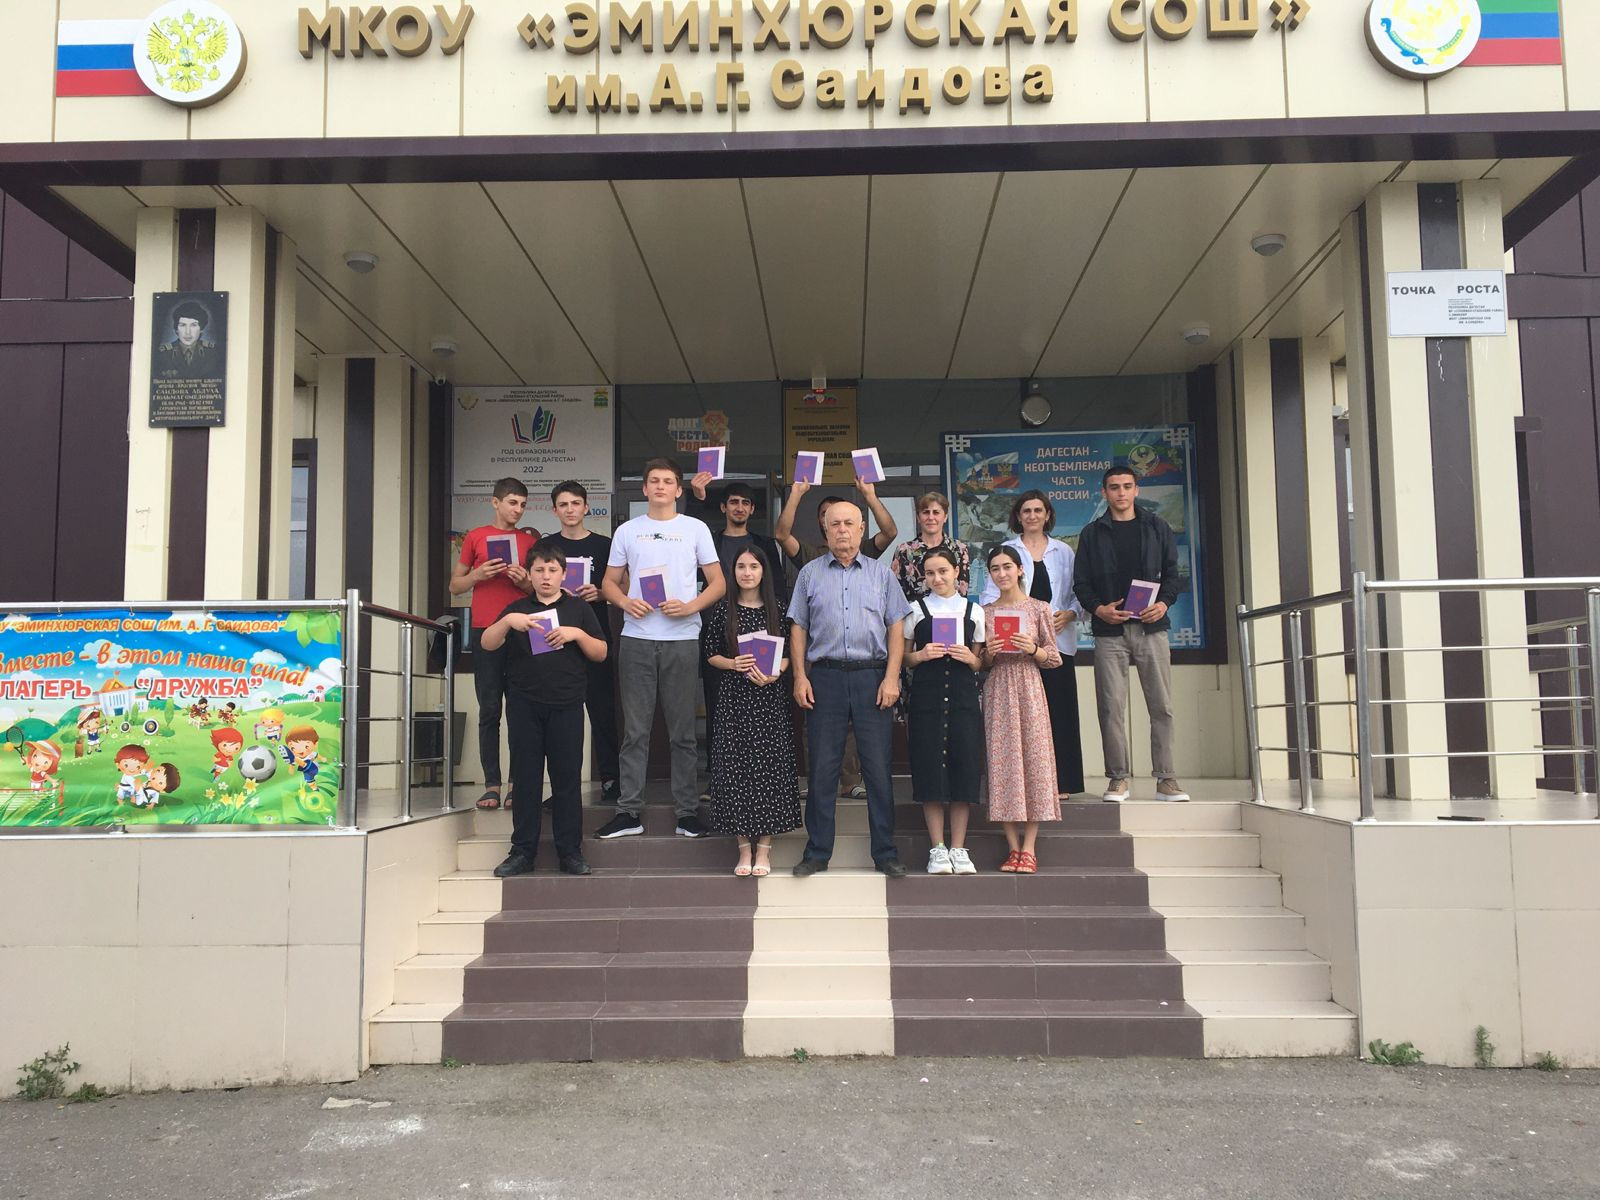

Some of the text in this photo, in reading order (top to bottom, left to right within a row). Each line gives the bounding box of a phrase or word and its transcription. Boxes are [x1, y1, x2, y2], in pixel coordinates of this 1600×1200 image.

[298, 0, 1311, 58] МКОУ «ЭМИНХЮРСКАЯ СОШ»
[770, 59, 1054, 115] Саидова
[1391, 285, 1500, 295] ТОЧКА РОСТА
[1036, 446, 1090, 458] ДАГЕСТАН
[522, 465, 544, 473] 2022
[1024, 460, 1111, 472] НЕОТЪЕМЛЕМАЯ
[1051, 476, 1085, 486] ЧАСТЬ
[1048, 490, 1090, 500] РОССИИ
[591, 508, 608, 516] 100
[122, 620, 156, 631] СОШ
[158, 620, 183, 631] ИМ.
[117, 649, 182, 666] этом
[187, 651, 247, 674] наша
[250, 662, 311, 687] сила!
[0, 679, 92, 698] ЛАГЕРЬ
